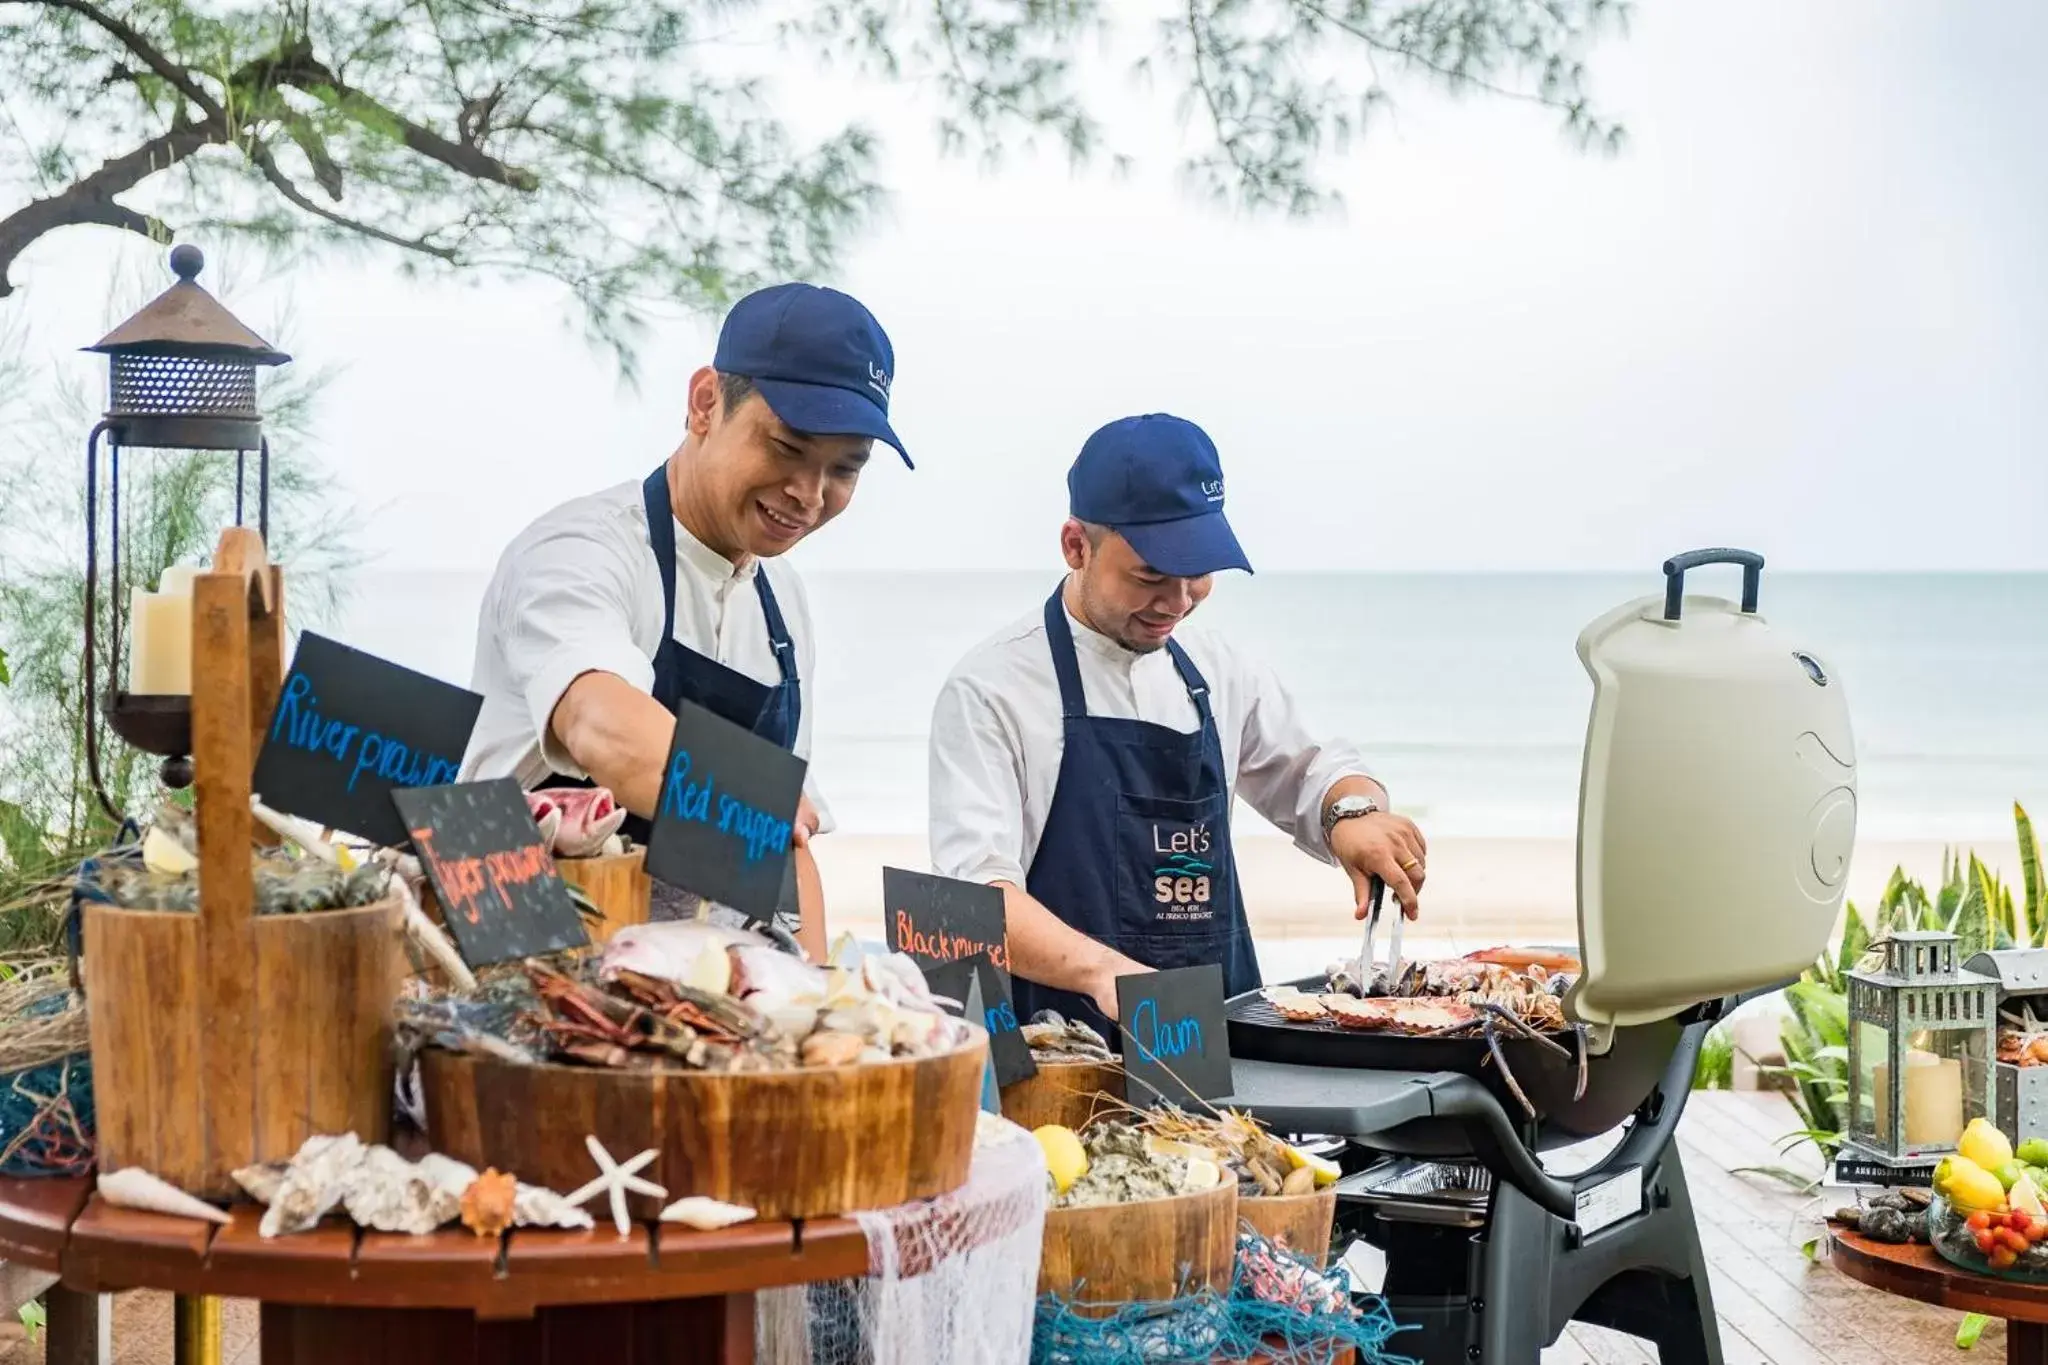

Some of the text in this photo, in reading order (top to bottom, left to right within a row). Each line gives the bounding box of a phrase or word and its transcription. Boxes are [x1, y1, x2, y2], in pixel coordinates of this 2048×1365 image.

[272, 673, 360, 762] River
[664, 750, 791, 860] Red snapper
[1152, 823, 1210, 854] Let's
[1154, 875, 1211, 903] sea
[896, 909, 951, 961] Black
[1132, 997, 1203, 1063] Clam
